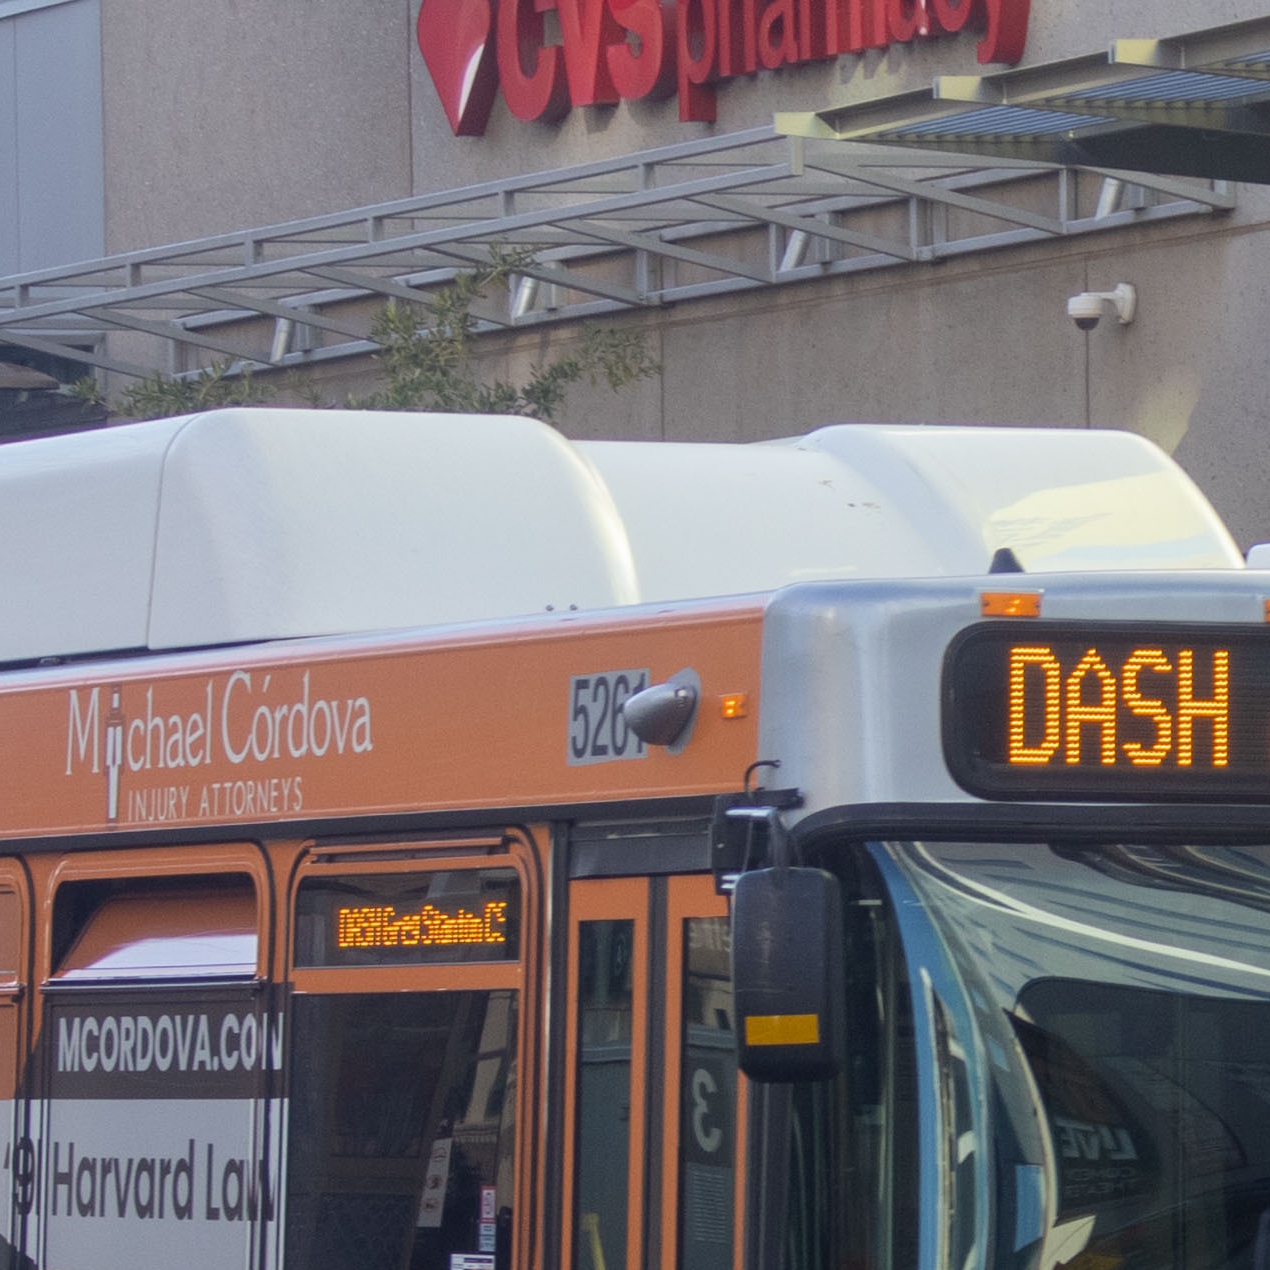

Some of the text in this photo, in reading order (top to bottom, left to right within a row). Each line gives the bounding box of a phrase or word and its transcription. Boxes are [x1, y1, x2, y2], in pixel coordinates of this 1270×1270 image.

[497, 0, 669, 121] CVS
[65, 669, 373, 800] Michael Córdova
[1009, 647, 1229, 766] DASH
[129, 776, 303, 822] INJURY ATTORNEYS
[52, 1138, 196, 1220] Harvard
